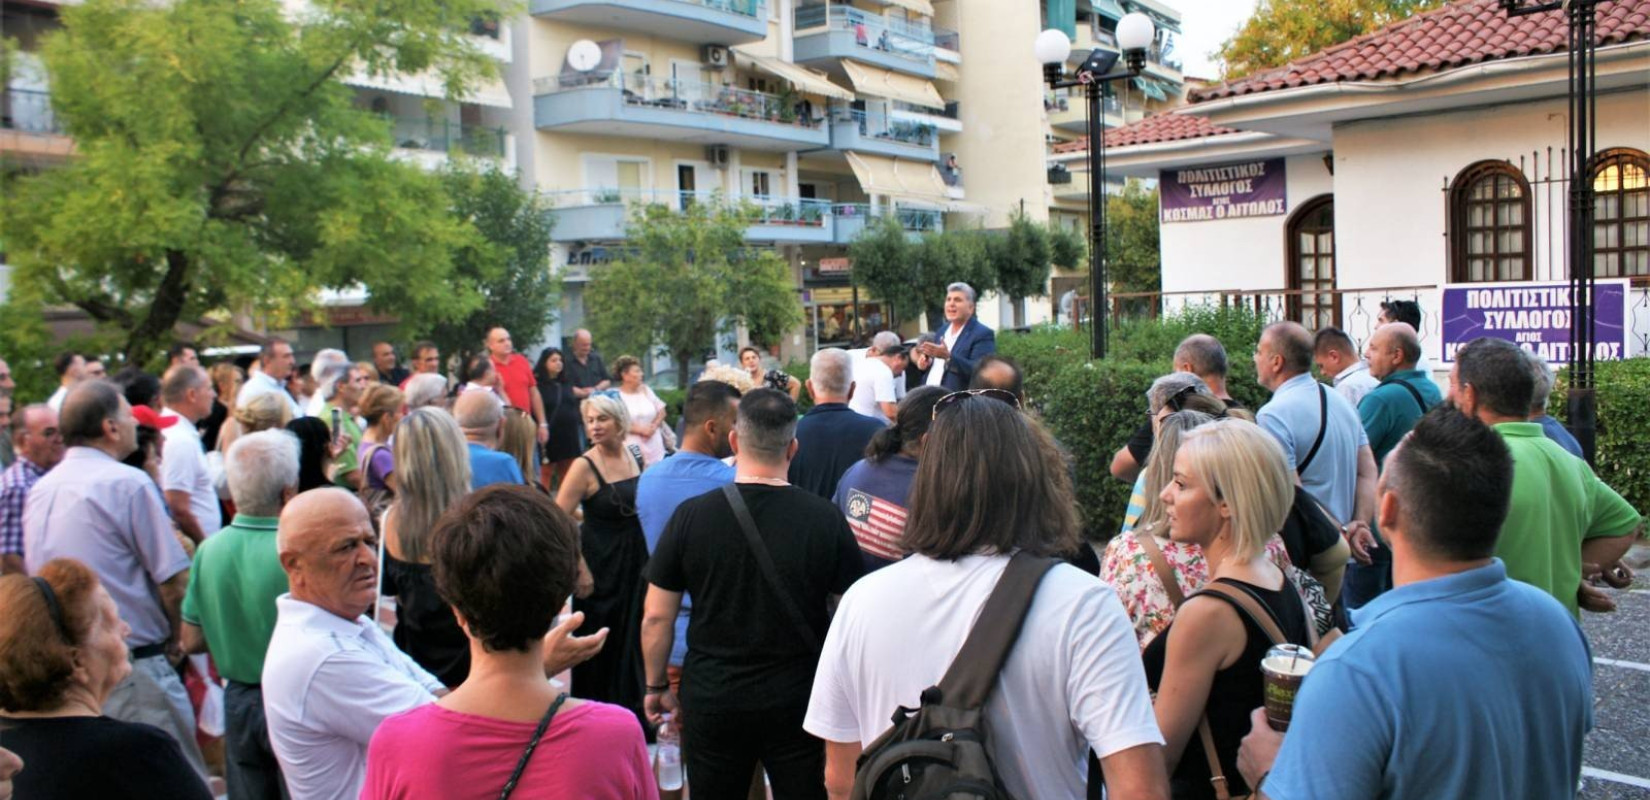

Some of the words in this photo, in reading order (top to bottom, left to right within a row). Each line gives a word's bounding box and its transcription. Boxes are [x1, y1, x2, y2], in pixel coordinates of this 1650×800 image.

[1177, 162, 1266, 184] ΠΟΛΙΤΙΣΤΙΚΟΣ
[1189, 179, 1253, 198] ΣΥΛΛΟΓΟΣ
[1163, 206, 1214, 222] ΚΟΣΜΑΣ
[1216, 205, 1225, 218] Ο
[1515, 332, 1542, 343] ΑΓΙΟΣ
